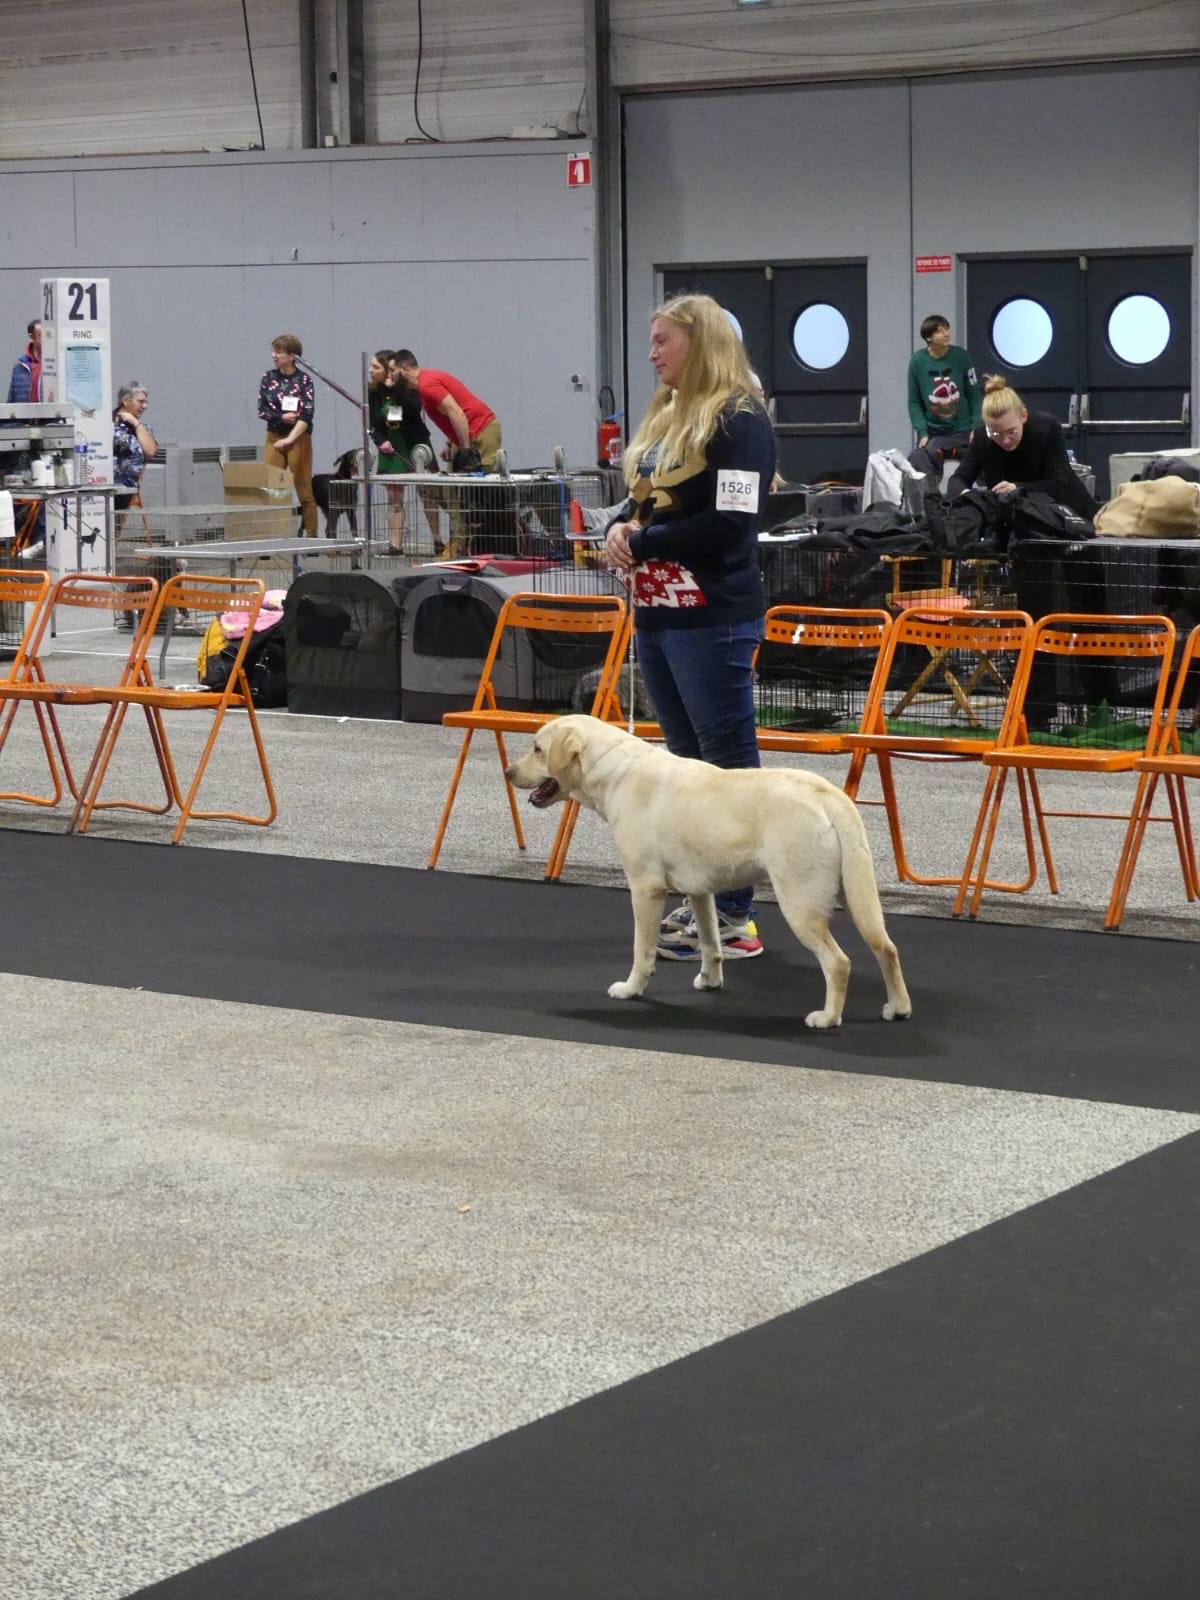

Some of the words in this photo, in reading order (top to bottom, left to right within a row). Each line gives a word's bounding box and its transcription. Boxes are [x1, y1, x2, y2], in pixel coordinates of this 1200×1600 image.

[68, 282, 98, 321] 21
[73, 330, 93, 339] RING
[720, 481, 752, 495] 1526
